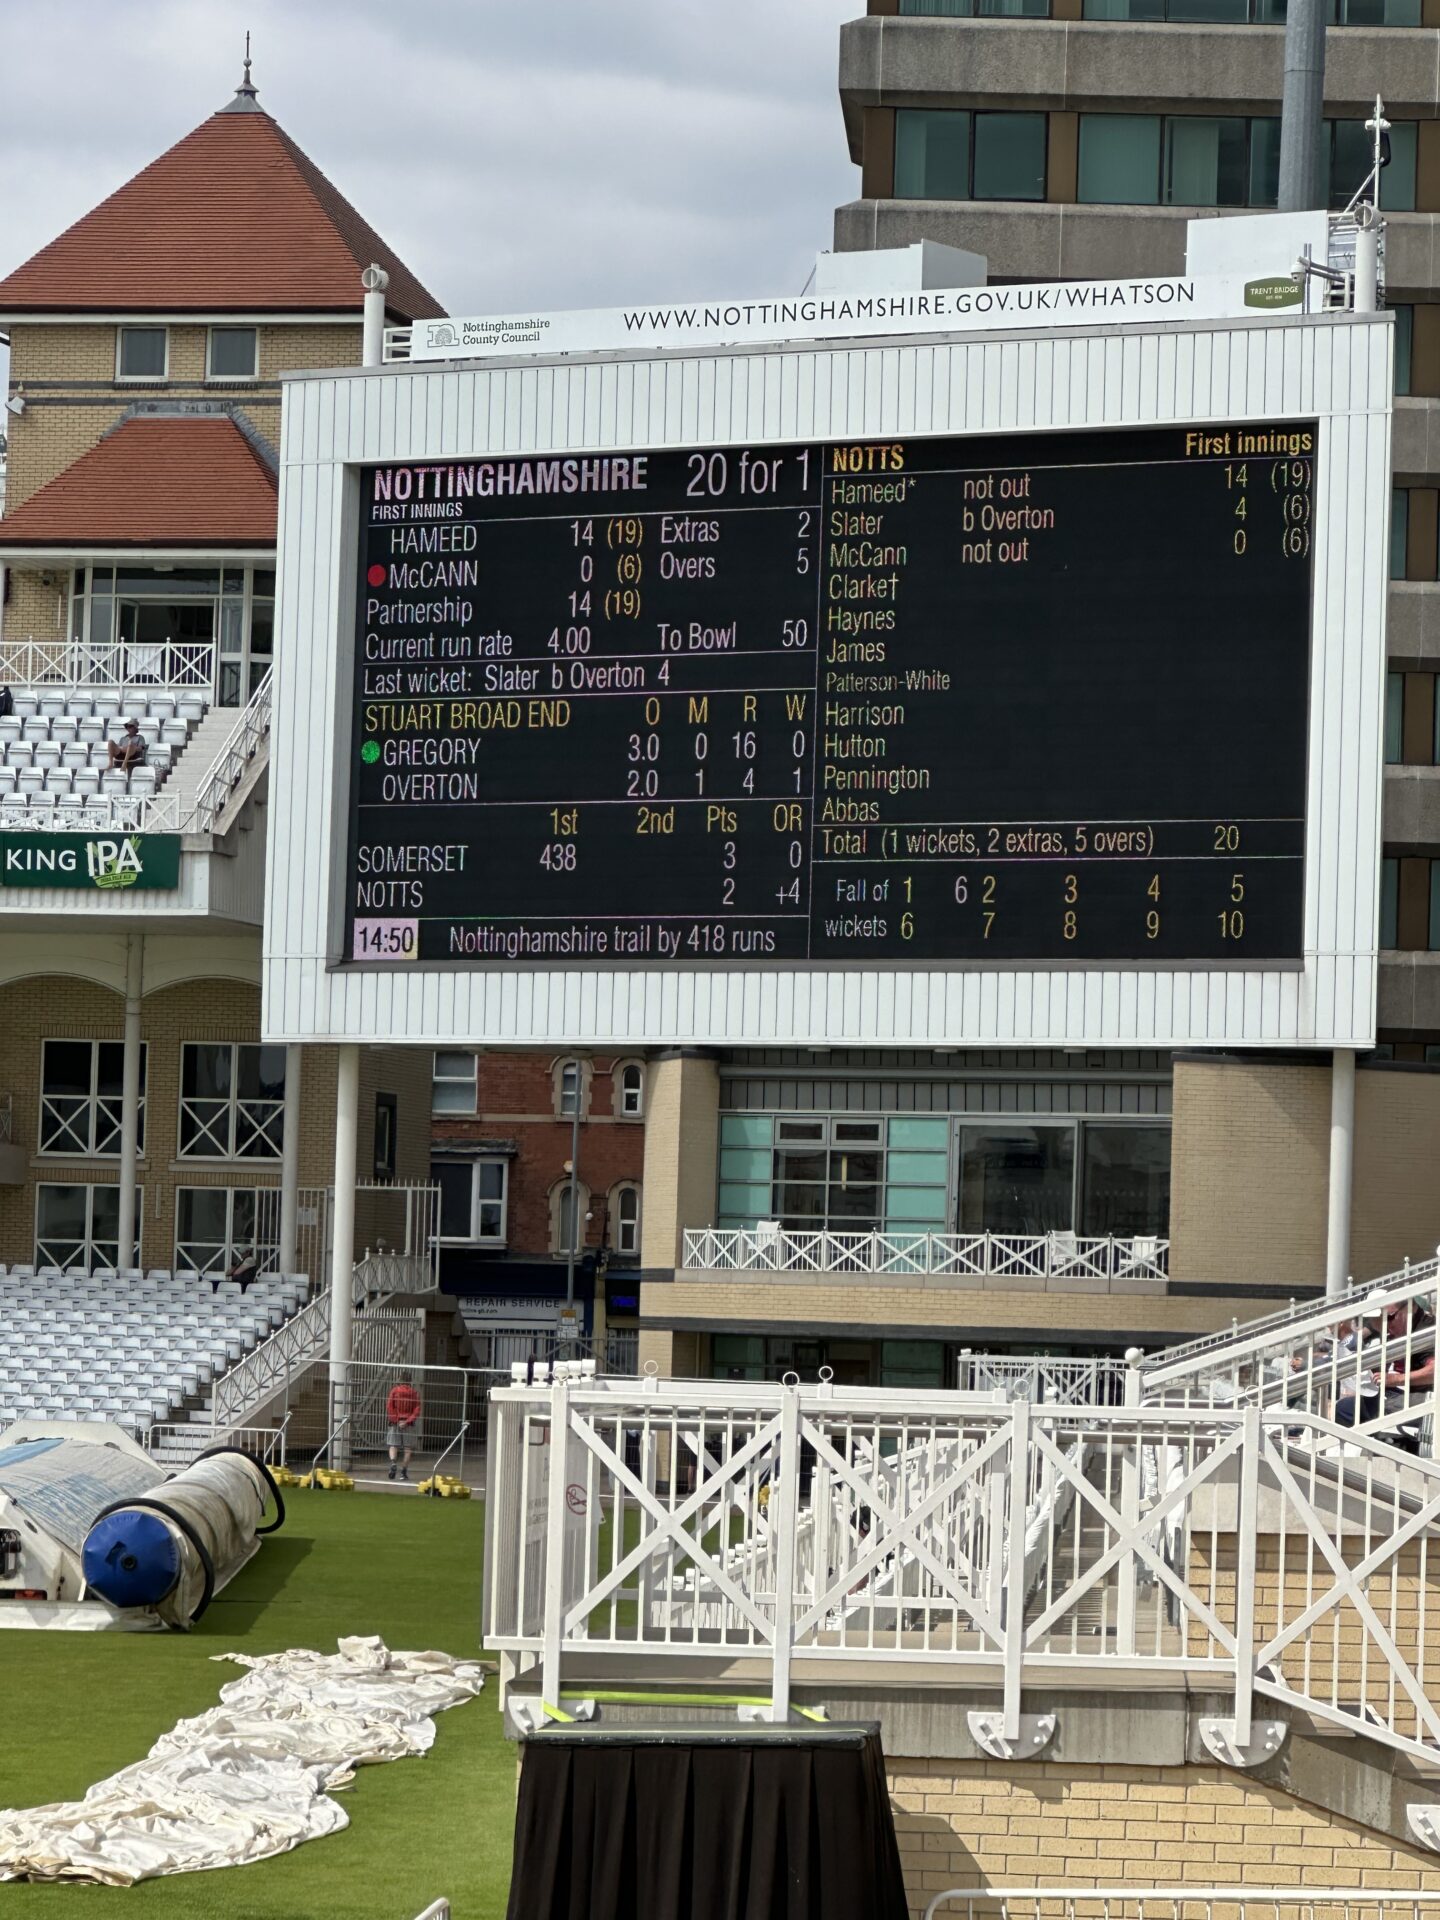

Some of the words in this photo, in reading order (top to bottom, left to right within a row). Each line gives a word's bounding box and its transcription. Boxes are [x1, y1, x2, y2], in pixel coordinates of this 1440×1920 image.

[1250, 287, 1273, 295] TRENT
[624, 282, 1195, 332] WWW.NOTTINGHAMSHIRE.GOV.UK/WHATSON
[462, 336, 500, 345] County
[501, 332, 540, 343] Council
[463, 318, 550, 332] Nottinghamshire
[833, 444, 904, 472] NOTTS
[1186, 431, 1230, 456] First
[1237, 430, 1312, 455] innings
[374, 457, 649, 500] NOTTINGHAMSHIRE
[686, 454, 727, 496] 20
[739, 451, 783, 494] for
[798, 450, 809, 491] 1
[964, 475, 994, 500] not
[1001, 474, 1030, 498] out
[1224, 463, 1248, 488] 14
[1271, 461, 1311, 490] (19)
[372, 504, 409, 520] FIRST
[411, 502, 463, 518] INNINGS
[831, 510, 883, 536] Slater
[963, 507, 974, 531] b
[981, 504, 1055, 531] Overton
[1234, 496, 1247, 521] 4
[1283, 495, 1310, 523] (6)
[392, 526, 477, 554] HAMEED
[571, 520, 594, 546] 14
[607, 519, 643, 549] (19)
[661, 517, 720, 545] Extras
[798, 512, 810, 538] 2
[660, 553, 716, 580] Overs
[797, 548, 809, 574] 5
[830, 543, 907, 569] McCann
[962, 539, 993, 563] not
[999, 538, 1029, 562] out
[1234, 530, 1246, 555] 0
[1282, 528, 1309, 558] (6)
[390, 561, 478, 589] McCANN
[581, 556, 593, 582] 0
[617, 554, 642, 584] (6)
[367, 598, 473, 627] Partnership
[569, 592, 591, 617] 14
[605, 589, 641, 620] (19)
[828, 606, 895, 635] Haynes
[366, 632, 436, 660] Current
[442, 636, 472, 657] run
[478, 631, 512, 656] rate
[547, 627, 591, 654] 4.00
[657, 624, 681, 650] To
[688, 622, 736, 649] Bowl
[782, 619, 808, 647] 50
[827, 639, 886, 664] James
[364, 668, 402, 695] Last
[408, 666, 472, 693] wicket:
[485, 664, 539, 692] Slater
[551, 663, 563, 689] b
[570, 663, 645, 689] Overton
[658, 660, 670, 685] 4
[826, 669, 950, 693] Patterson-White
[365, 703, 444, 731] STUART
[451, 701, 520, 729] BROAD
[529, 700, 570, 728] END
[645, 697, 660, 725] O
[689, 698, 708, 724] M
[744, 696, 756, 722] R
[786, 694, 806, 720] W
[825, 701, 905, 726] Harrison
[383, 738, 480, 766] GREGORY
[628, 734, 660, 761] 3.0
[695, 733, 707, 760] 0
[733, 731, 755, 759] 16
[793, 730, 805, 757] 0
[825, 734, 886, 758] Hutton
[382, 774, 478, 801] OVERTON
[627, 770, 658, 797] 2.0
[695, 769, 704, 795] 1
[743, 768, 754, 794] 4
[793, 767, 802, 793] 1
[824, 766, 929, 795] Pennington
[550, 809, 578, 835] 1st
[637, 807, 674, 834] 2nd
[707, 806, 737, 832] Pts
[774, 804, 802, 831] OR
[822, 798, 879, 822] Abbas
[7, 849, 77, 871] KING
[87, 838, 143, 877] IPA
[358, 845, 468, 874] SOMERSET
[540, 843, 577, 871] 438
[723, 842, 736, 869] 3
[789, 841, 802, 867] 0
[822, 829, 866, 855] Total
[881, 829, 898, 860] (1
[906, 827, 980, 858] wickets,
[988, 828, 1000, 853] 2
[1006, 827, 1068, 856] extras,
[1075, 827, 1087, 852] 5
[1094, 825, 1154, 856] overs)
[1214, 825, 1239, 851] 20
[357, 880, 423, 908] NOTTS
[722, 878, 734, 905] 2
[775, 878, 799, 905] +4
[836, 877, 866, 902] Fall
[872, 877, 889, 902] of
[903, 877, 912, 902] 1
[955, 877, 967, 903] 6
[983, 876, 996, 902] 2
[1065, 875, 1077, 901] 3
[1148, 874, 1160, 900] 4
[1231, 875, 1243, 900] 5
[358, 926, 414, 953] 14:50
[825, 912, 887, 938] wickets
[901, 912, 914, 939] 6
[983, 912, 996, 938] 7
[1064, 912, 1077, 938] 8
[1147, 911, 1159, 937] 9
[1218, 911, 1243, 937] 10
[450, 924, 608, 958] Nottinghamshire
[614, 924, 652, 951] trail
[658, 924, 681, 956] by
[687, 924, 725, 952] 418
[732, 929, 775, 951] runs
